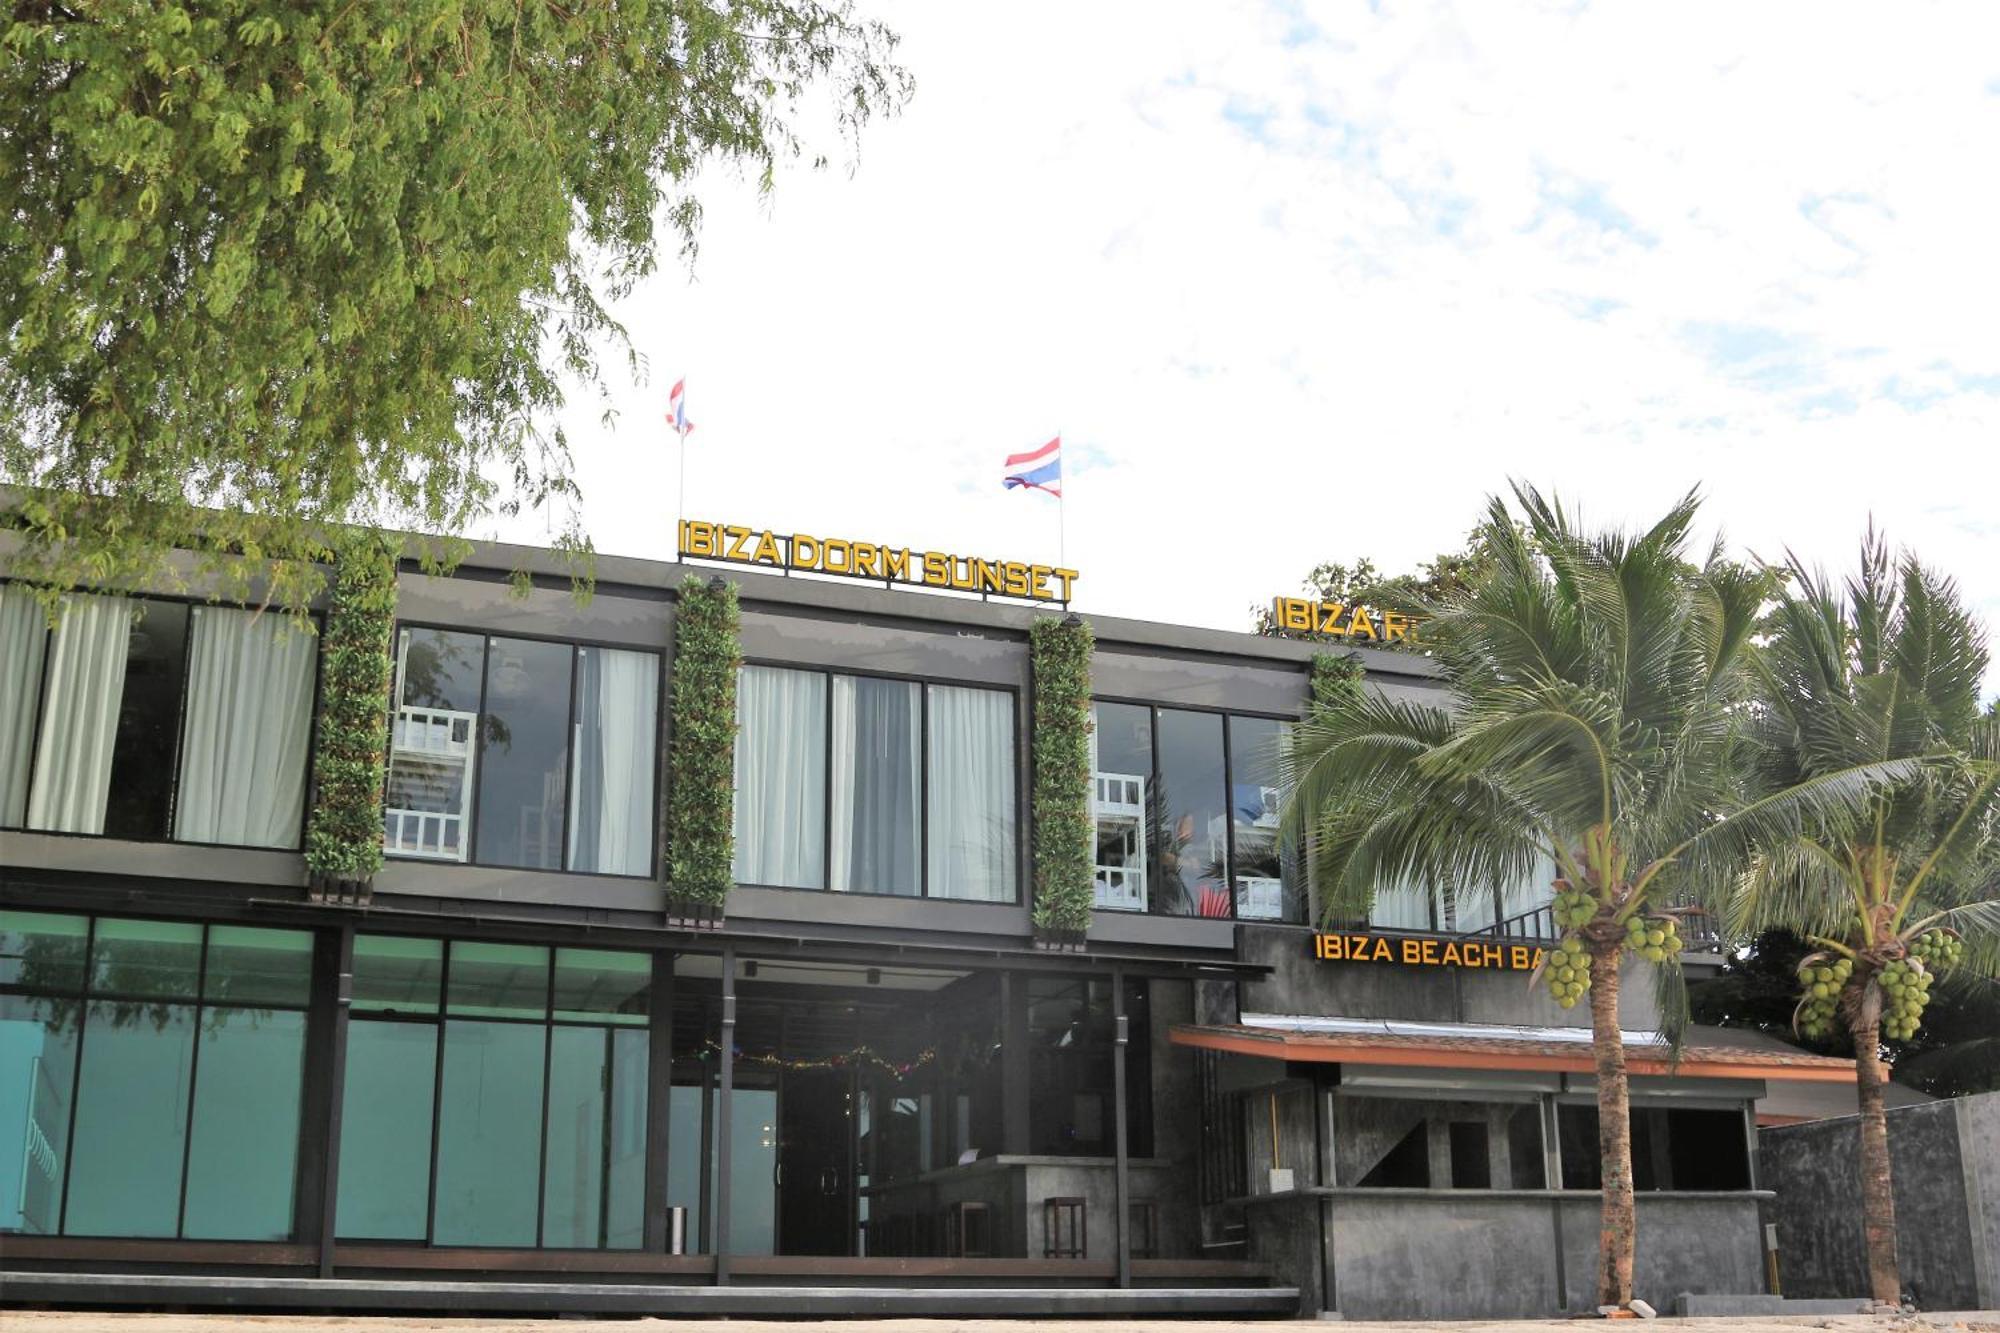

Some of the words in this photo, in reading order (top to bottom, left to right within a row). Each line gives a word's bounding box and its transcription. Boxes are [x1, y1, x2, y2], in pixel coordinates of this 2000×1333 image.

[678, 519, 783, 565] IBIZA
[792, 533, 910, 581] DORM
[922, 551, 1079, 602] SUNSET
[1273, 596, 1377, 641] IBIZA
[1316, 935, 1393, 961] IBIZA
[1403, 939, 1502, 967] BEACH
[1511, 945, 1545, 970] BA
